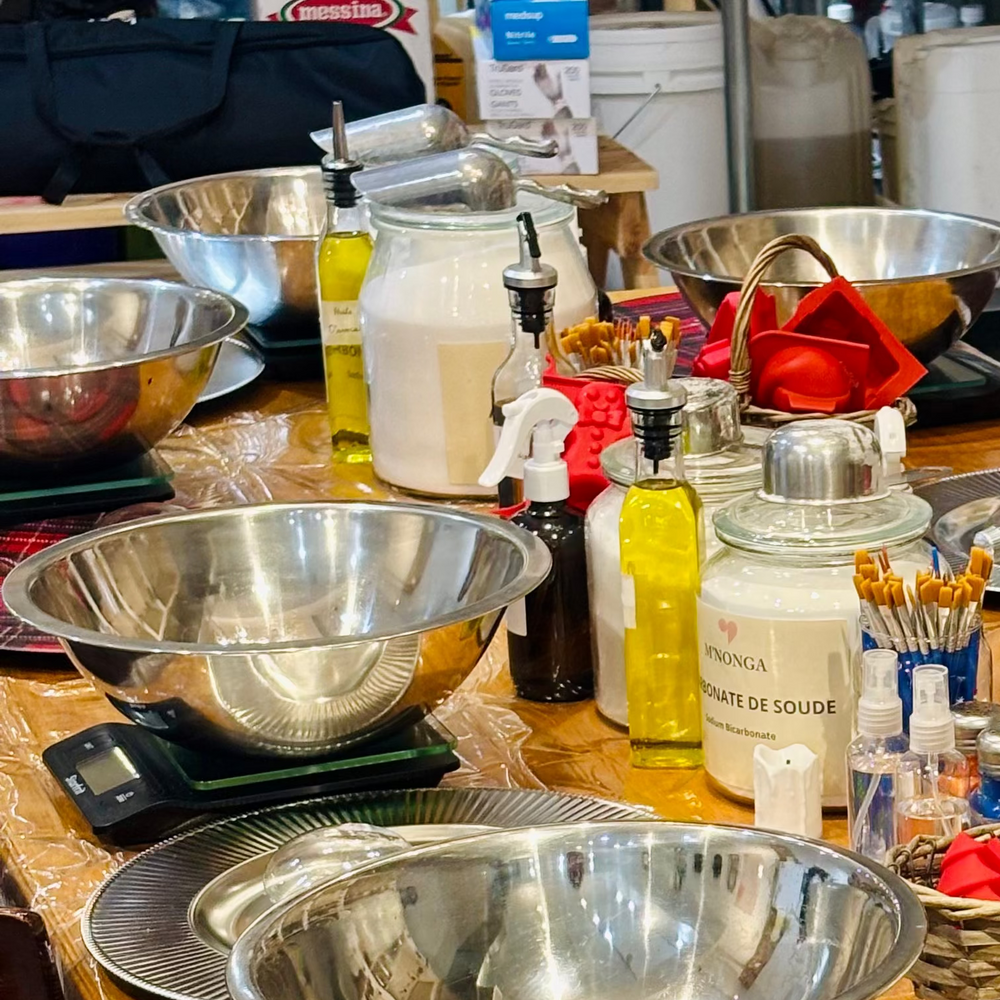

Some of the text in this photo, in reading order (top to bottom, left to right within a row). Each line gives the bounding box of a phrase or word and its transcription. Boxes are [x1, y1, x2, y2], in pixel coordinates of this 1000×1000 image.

[299, 2, 385, 20] messina
[704, 642, 768, 673] M'NONGA
[700, 676, 837, 715] BONATE DE SOUDE
[725, 722, 777, 741] Bicarbonate
